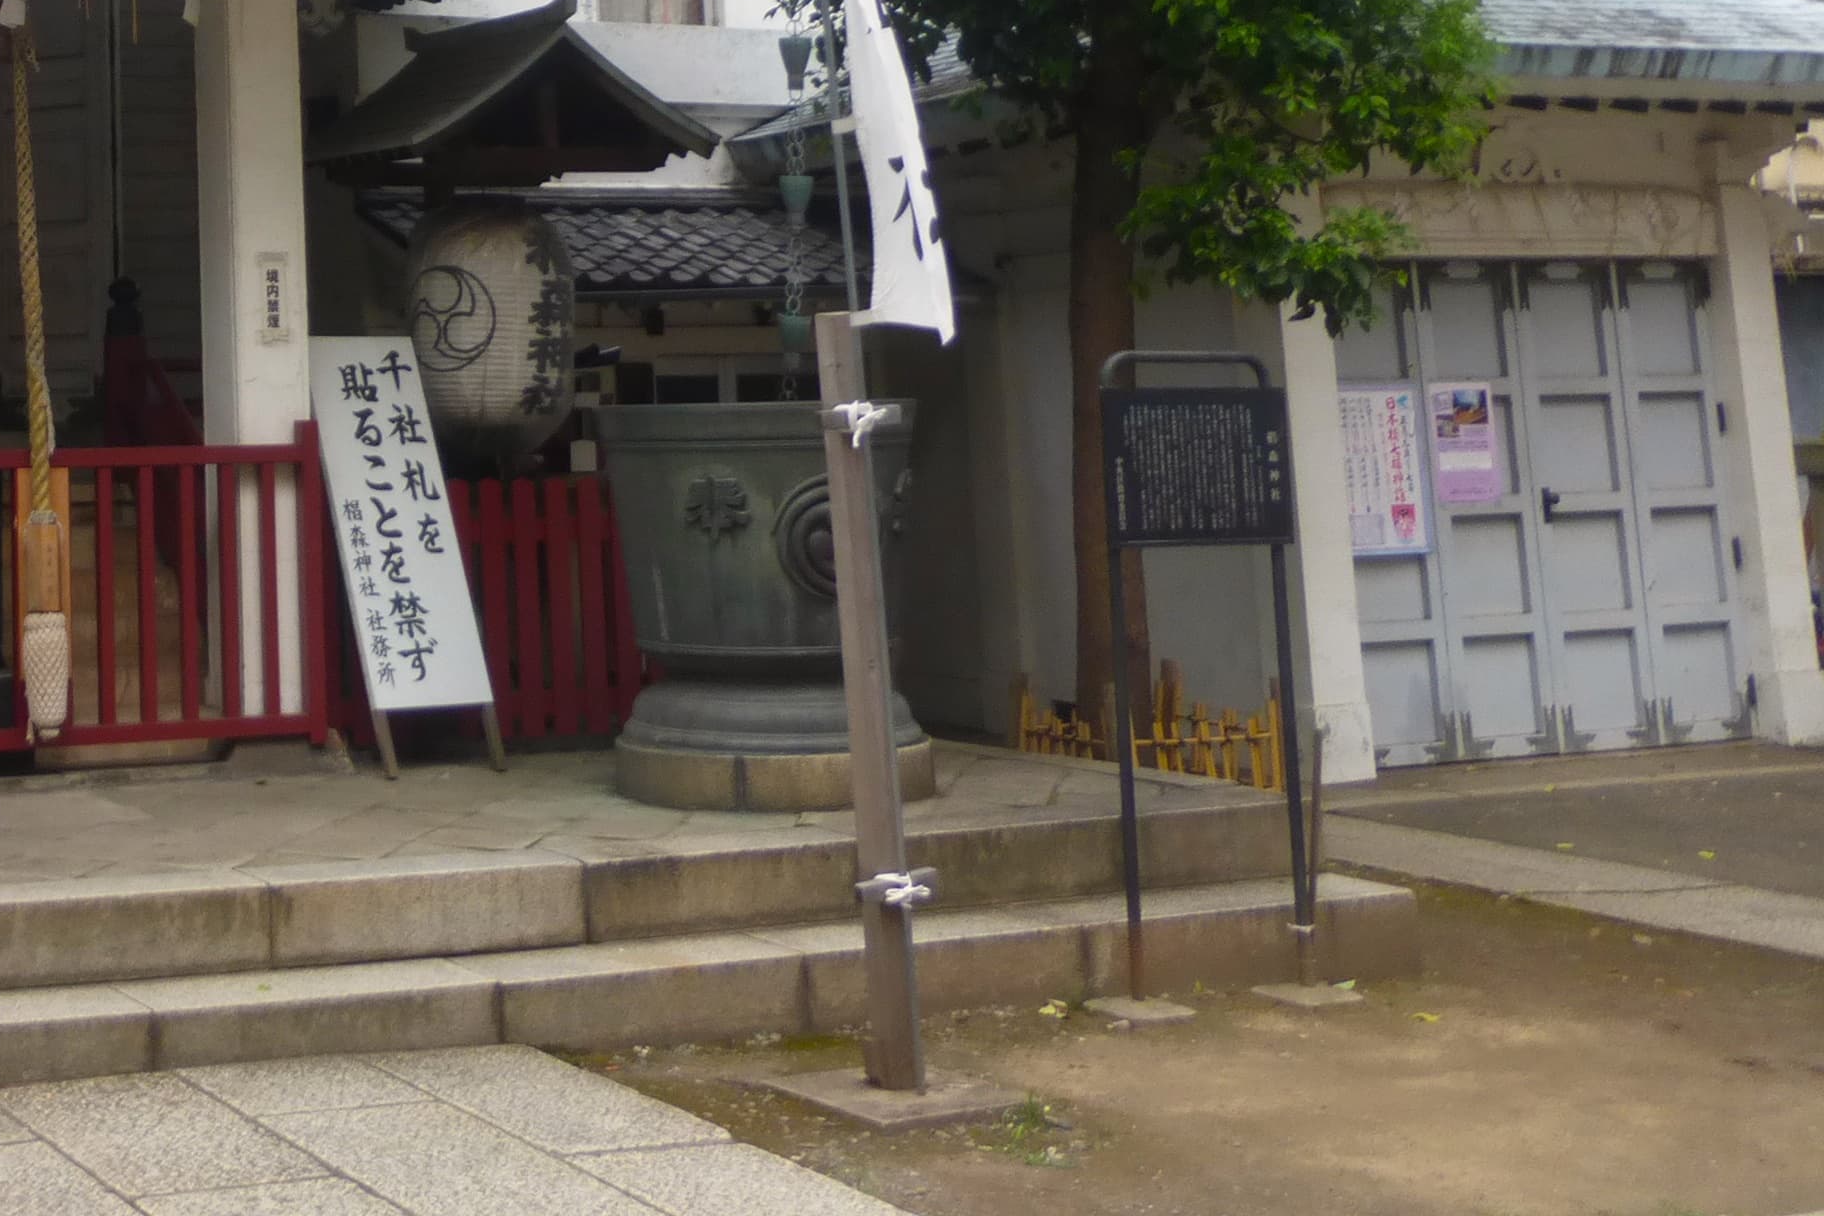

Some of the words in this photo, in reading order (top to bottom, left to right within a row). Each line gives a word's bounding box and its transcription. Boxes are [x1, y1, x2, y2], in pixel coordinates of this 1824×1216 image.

[338, 362, 439, 682] 貼ることを禁ず
[377, 350, 445, 554] 千社札を
